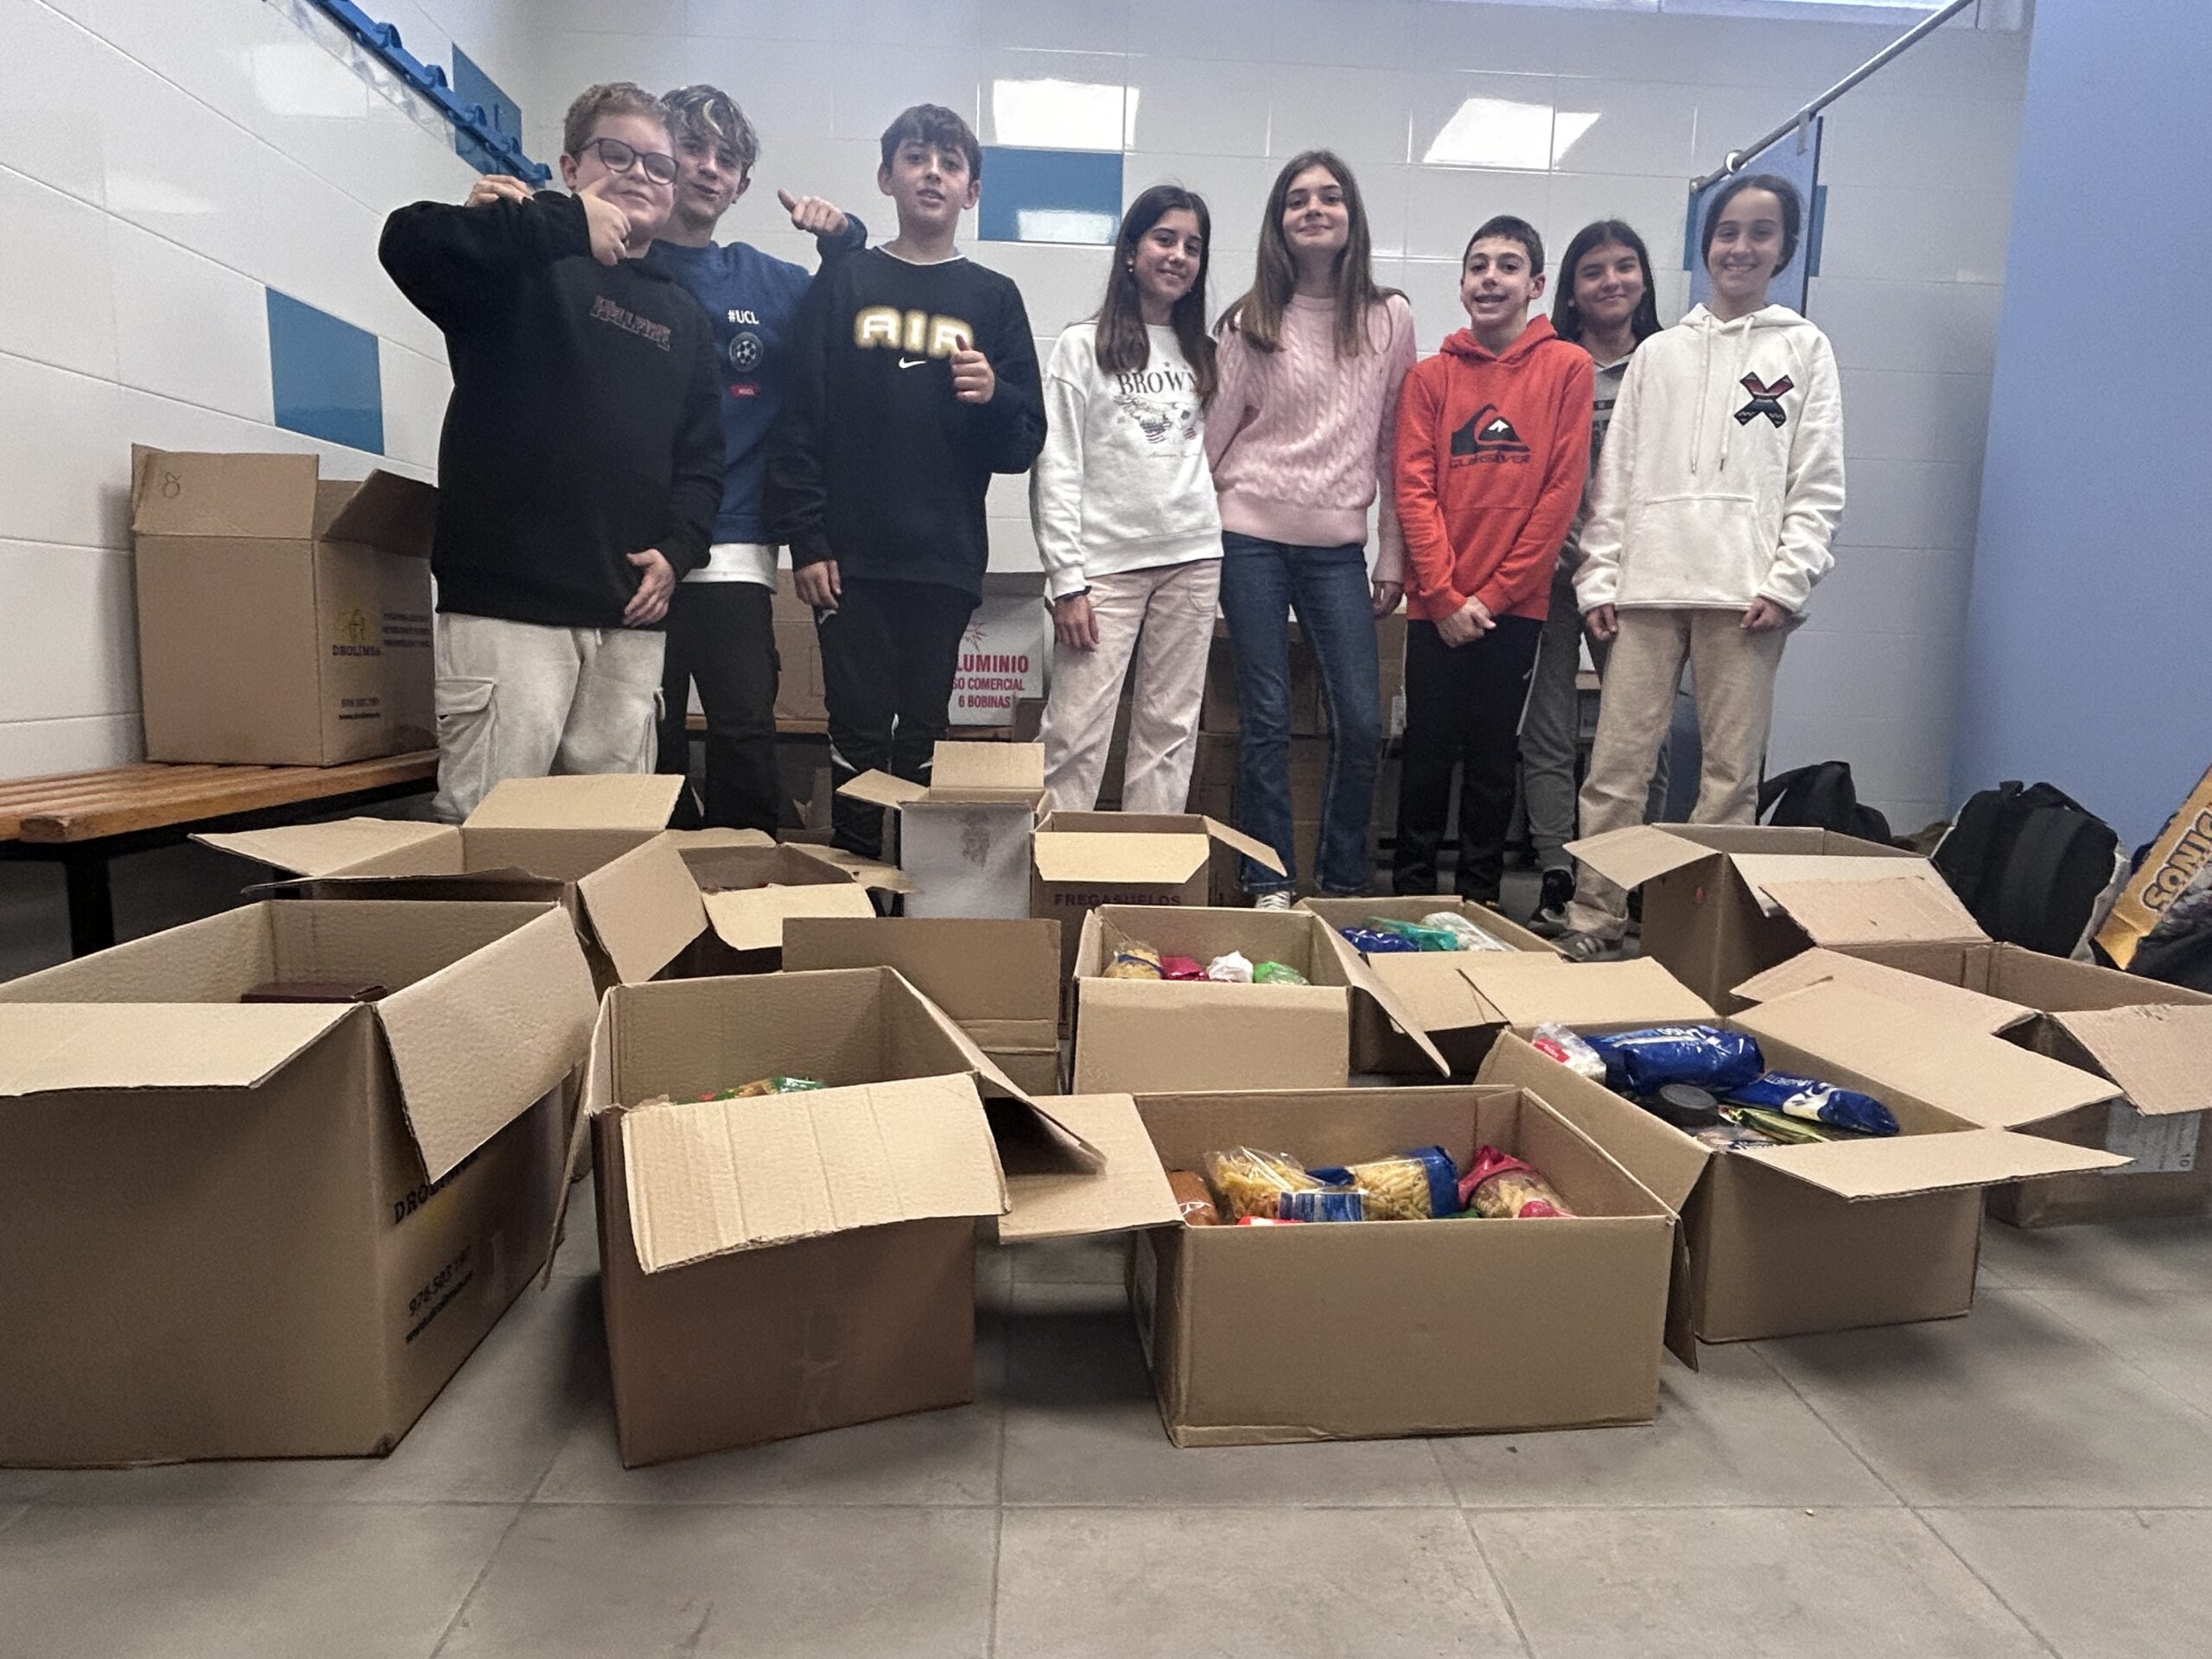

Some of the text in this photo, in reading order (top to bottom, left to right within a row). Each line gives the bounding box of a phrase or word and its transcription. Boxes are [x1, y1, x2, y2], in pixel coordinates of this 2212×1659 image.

[727, 309, 760, 325] #UCL
[855, 305, 973, 359] AIR
[968, 677, 1026, 691] COMERCIAL
[958, 695, 1011, 709] 6 BOBINAS
